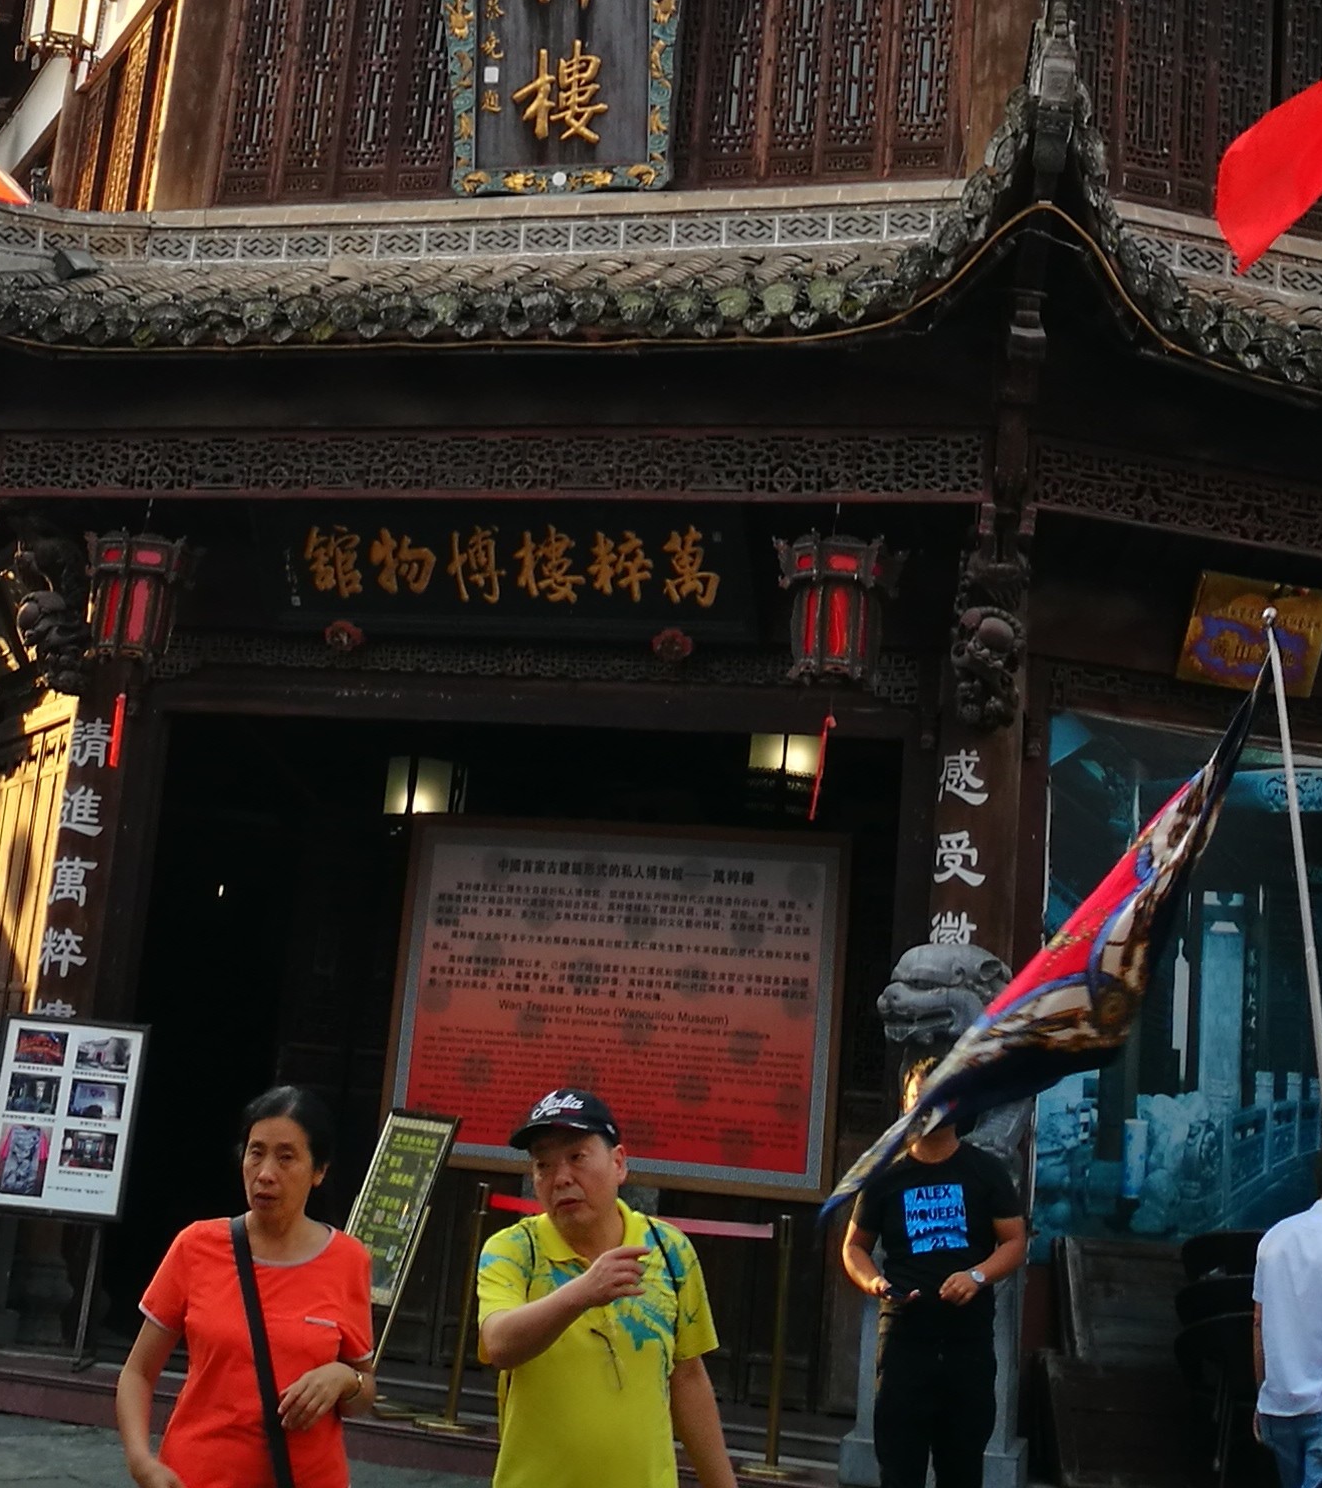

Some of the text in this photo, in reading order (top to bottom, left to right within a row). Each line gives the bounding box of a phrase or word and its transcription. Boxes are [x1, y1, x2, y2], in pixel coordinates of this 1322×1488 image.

[33, 716, 113, 1018] 請進萬粹
[498, 999, 523, 1011] Wan
[526, 1000, 572, 1015] Treasure
[576, 1005, 610, 1016] House
[915, 1185, 952, 1201] ALEX
